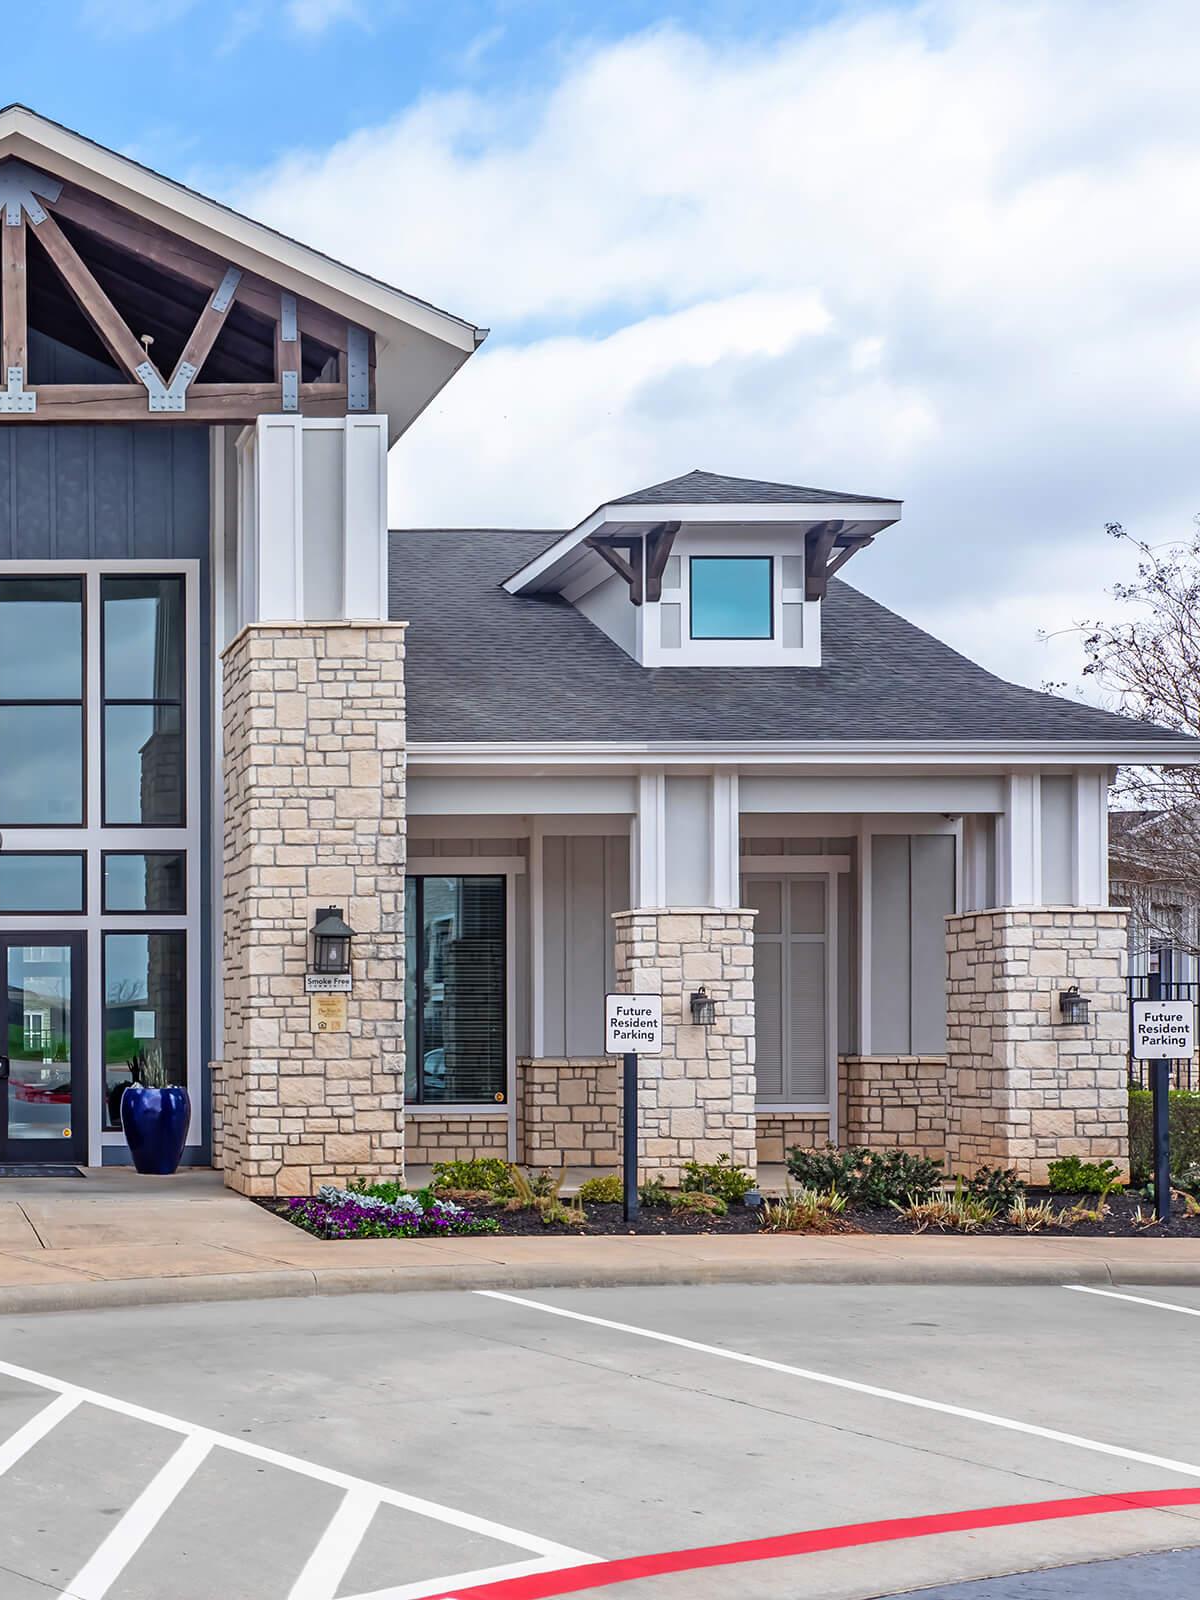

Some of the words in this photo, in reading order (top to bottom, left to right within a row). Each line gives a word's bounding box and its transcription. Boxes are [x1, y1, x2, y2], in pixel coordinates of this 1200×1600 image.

[307, 977, 332, 985] Smoke
[333, 977, 350, 985] Free
[616, 1006, 652, 1016] Future
[610, 1017, 658, 1028] Resident
[1144, 1012, 1183, 1022] Future
[1138, 1023, 1190, 1034] Resident
[613, 1029, 655, 1042] Parking
[1142, 1035, 1186, 1048] Parking
